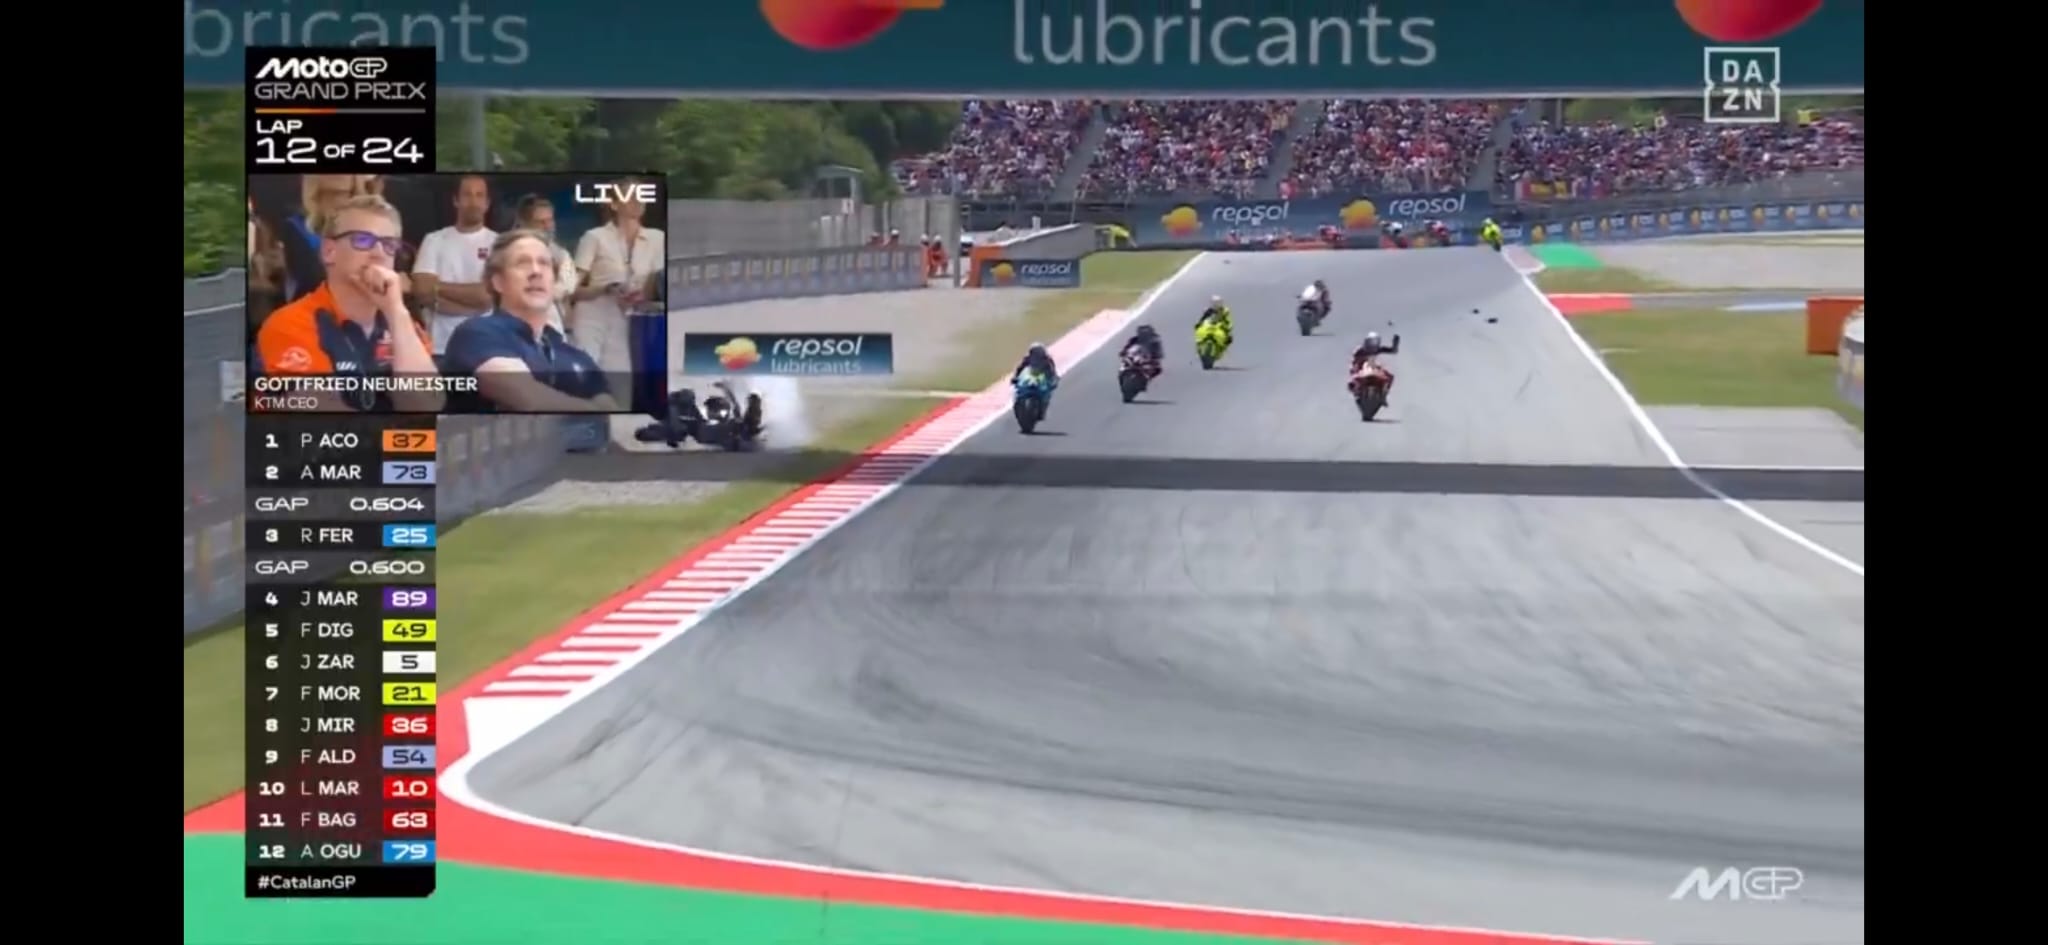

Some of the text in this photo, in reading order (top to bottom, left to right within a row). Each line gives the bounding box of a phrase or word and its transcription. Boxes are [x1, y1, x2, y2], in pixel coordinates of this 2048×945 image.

[1014, 0, 1436, 66] lubricants
[1212, 201, 1289, 226] repsol
[1388, 194, 1466, 219] repsol
[1021, 262, 1072, 275] repsol
[772, 336, 863, 358] repsol
[771, 358, 861, 374] lubricants
